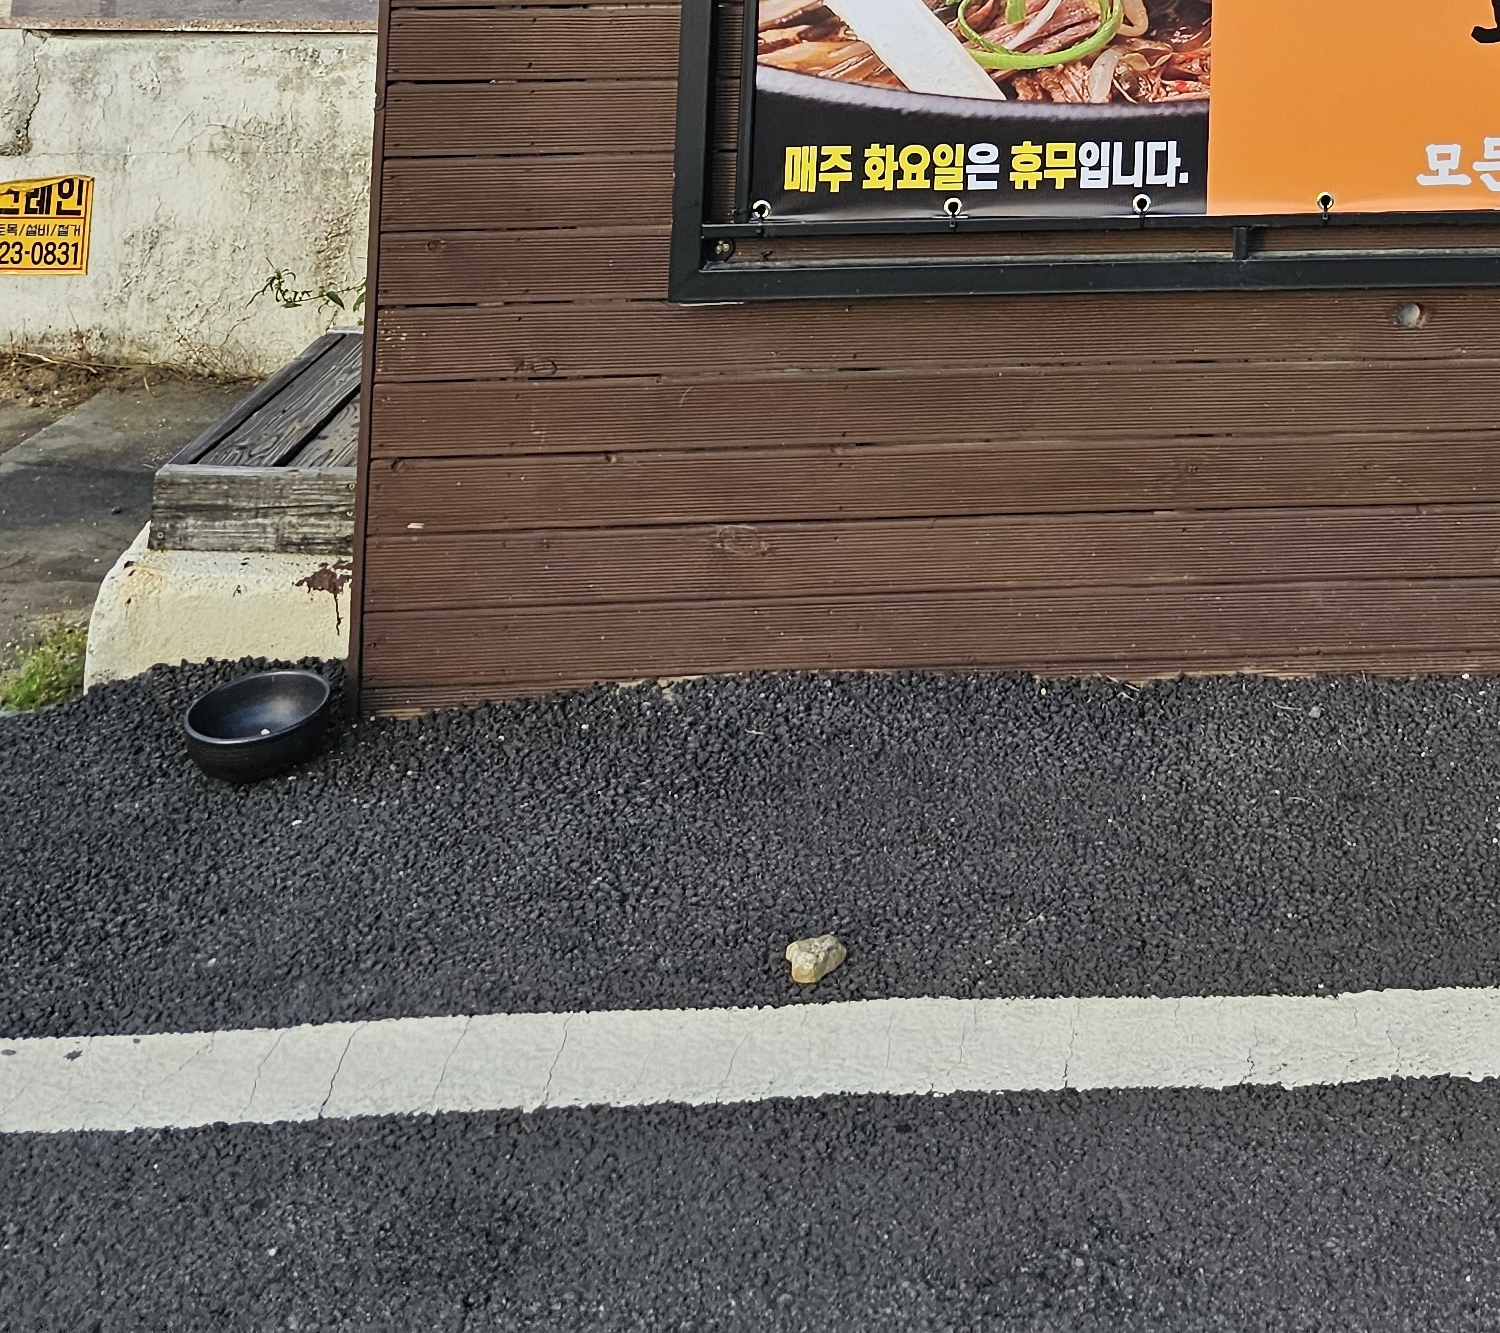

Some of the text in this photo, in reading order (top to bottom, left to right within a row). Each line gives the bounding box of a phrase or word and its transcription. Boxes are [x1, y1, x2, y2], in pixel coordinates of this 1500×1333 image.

[783, 139, 1190, 194] 매주 화요일은 휴무입니다.
